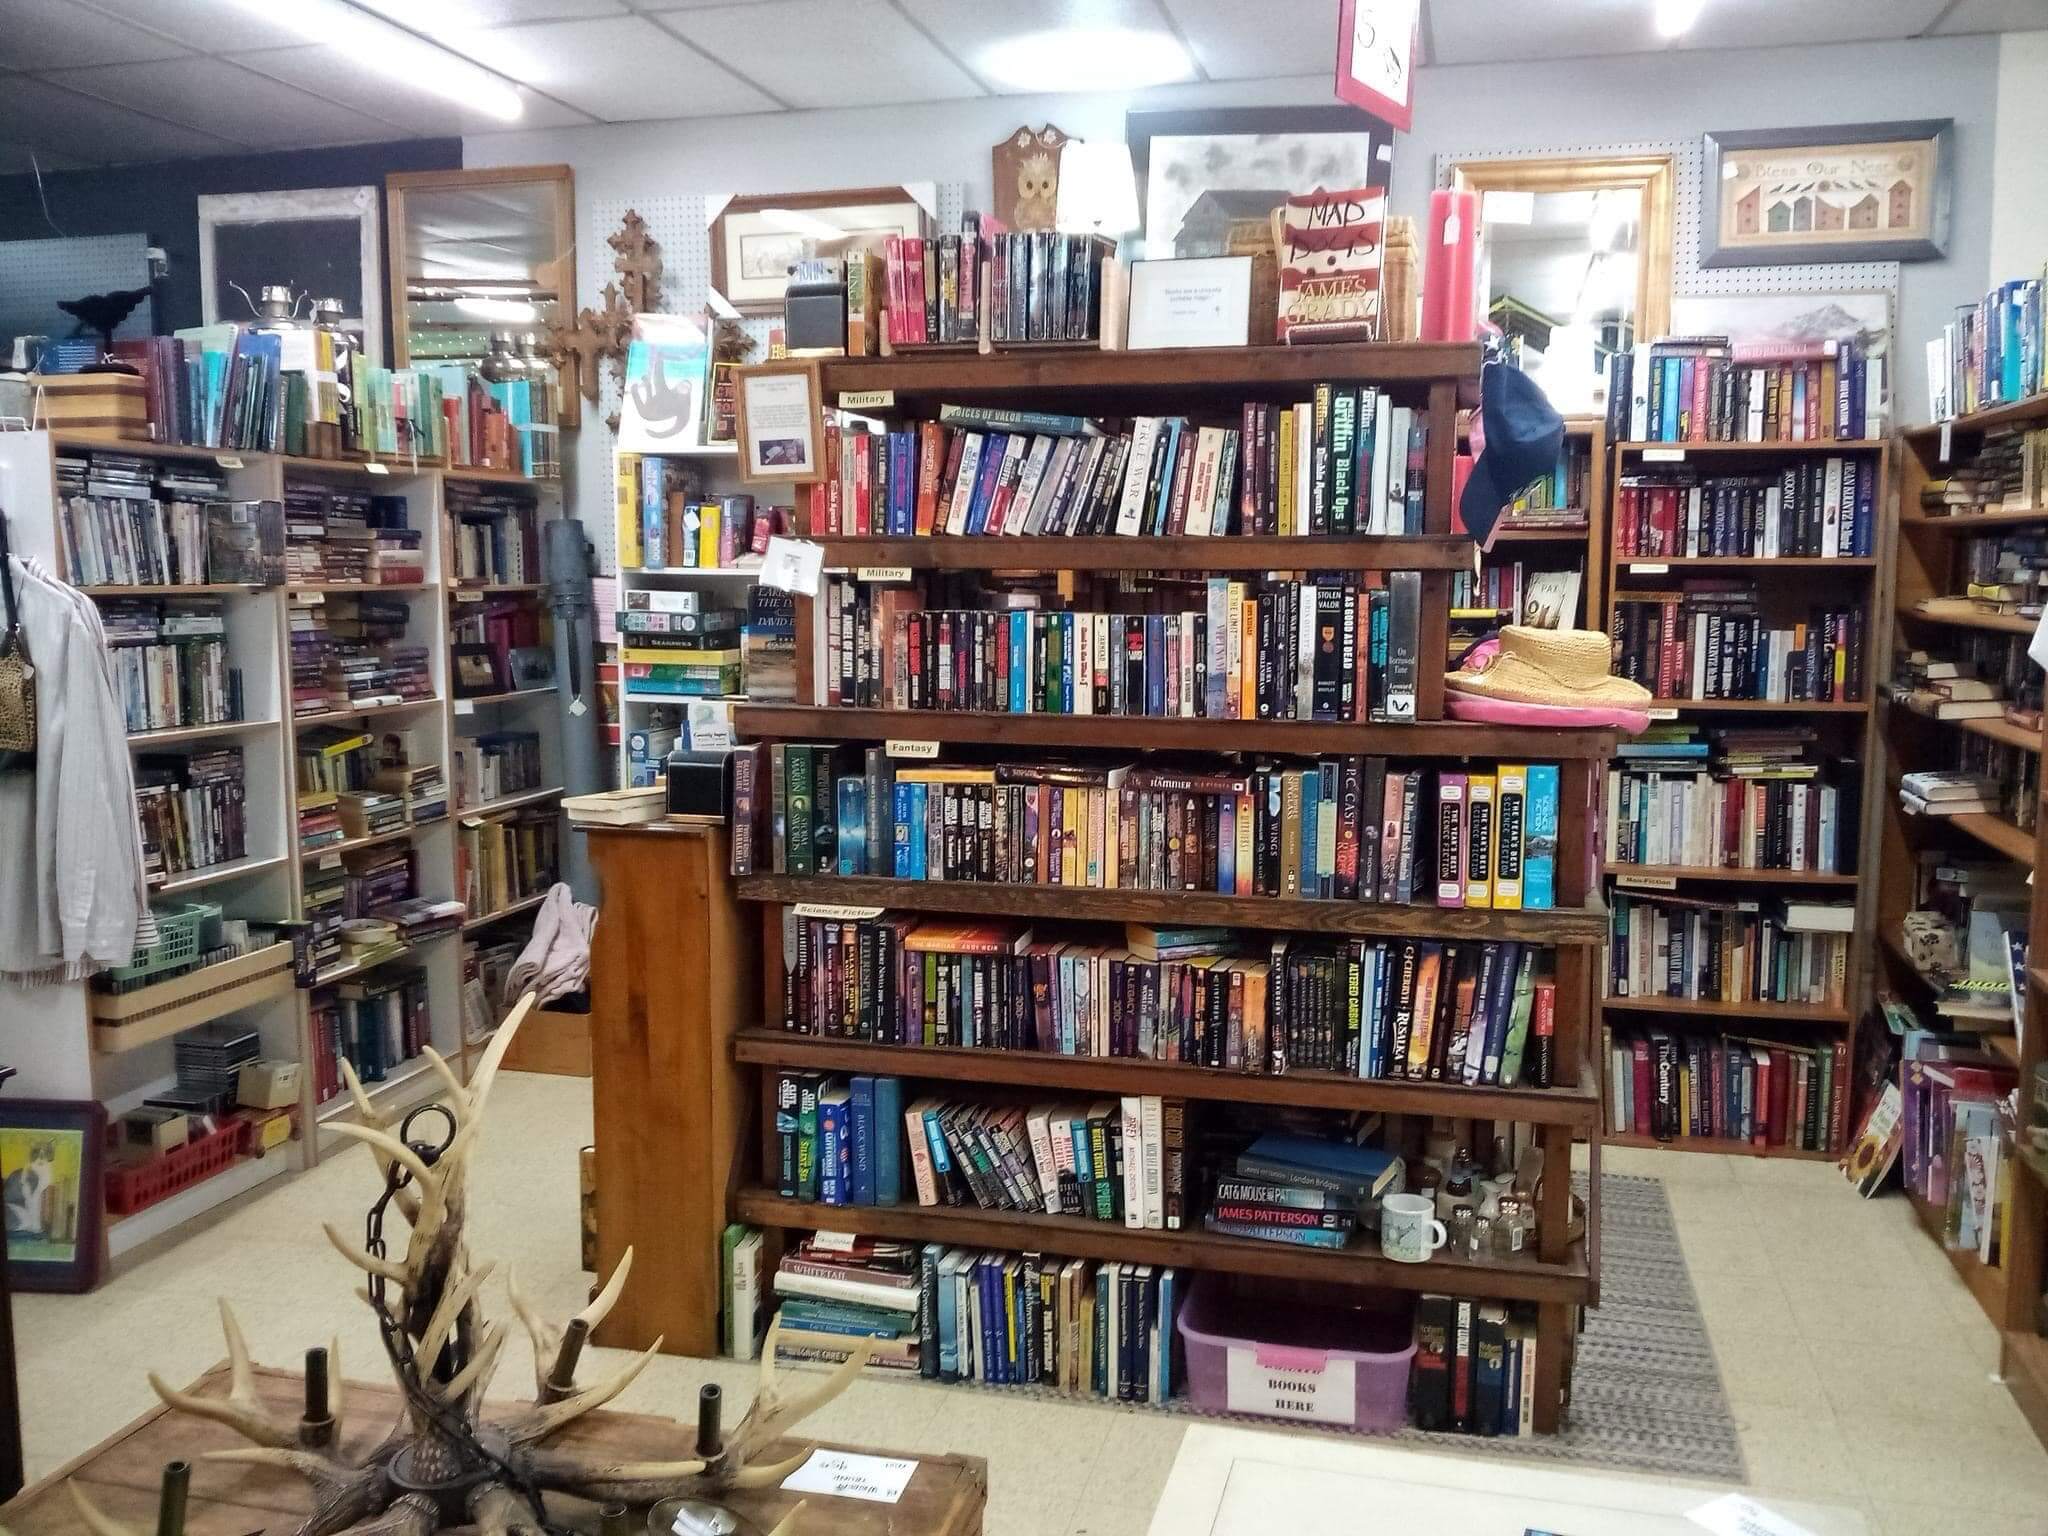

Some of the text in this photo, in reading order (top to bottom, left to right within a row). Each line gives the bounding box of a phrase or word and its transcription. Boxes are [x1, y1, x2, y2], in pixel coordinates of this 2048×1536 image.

[1306, 200, 1366, 230] MAD
[1290, 230, 1375, 263] DOGS
[1295, 277, 1368, 303] JAMES
[1286, 297, 1376, 325] GRADY
[847, 394, 886, 406] Military
[926, 439, 936, 471] SNIPER
[1128, 422, 1151, 498] TRUE WAR
[1331, 396, 1354, 521] Griffin Black Ops
[1841, 461, 1855, 521] DEAN KOONTZ
[866, 568, 905, 579] Military
[758, 598, 781, 607] THE
[1229, 586, 1238, 634] TO THE LIMIT
[1317, 591, 1341, 601] STOLEN
[1318, 601, 1340, 609] VALOR
[1343, 596, 1353, 608] AS
[757, 616, 784, 626] DAVID
[1343, 608, 1353, 633] GOOD
[1215, 624, 1226, 673] VIETNAM
[1708, 616, 1720, 667] DEAN KOONTZ
[1343, 646, 1353, 670] DEAD
[892, 743, 932, 754] Fantasy
[791, 757, 801, 792] MARTIN
[1286, 775, 1295, 820] SPYGLASS
[1343, 792, 1356, 828] CAST
[1402, 821, 1412, 834] and
[1451, 808, 1459, 823] THE
[1480, 808, 1489, 821] THE
[1534, 798, 1542, 832] FICTION
[791, 813, 801, 851] SWORDS
[801, 817, 809, 846] STORM
[1270, 822, 1279, 857] WINGS
[1401, 834, 1412, 852] Black
[1442, 804, 1451, 878] SCIENCE FICTION
[1471, 804, 1481, 878] SCIENCE FICTION
[1501, 796, 1511, 876] SCIENCE FICTION
[1509, 800, 1520, 872] THE YEAR'S BEST
[1399, 852, 1411, 881] Mountain
[1450, 855, 1459, 873] BEST
[1479, 855, 1488, 871] BEST
[800, 905, 840, 915] Science
[879, 930, 887, 947] BEST
[981, 944, 998, 952] WEIR
[848, 945, 856, 984] BALANCE
[1126, 977, 1135, 1016] LEGACY
[1141, 984, 1149, 1014] WORLDS
[1348, 963, 1360, 1030] ALTERED CARBON
[1394, 1012, 1410, 1061] RUSALKA
[1659, 1044, 1671, 1104] The Century
[781, 1079, 790, 1109] CUSSLER
[788, 1084, 797, 1105] CLIVE
[857, 1114, 867, 1171] BLACK WIND
[1126, 1117, 1137, 1142] PREY
[800, 1140, 809, 1182] SILENT SEA
[1053, 1136, 1065, 1169] CRICHTON
[1063, 1136, 1074, 1168] MICHAEL
[1092, 1128, 1105, 1179] MICHAEL CRICHTON
[1146, 1143, 1159, 1166] MICHAEL
[1129, 1174, 1137, 1202] CRICHTON
[1147, 1168, 1159, 1196] CRICHTON
[1240, 1185, 1267, 1202] MOUSE
[1289, 1175, 1340, 1191] London Bridges
[1096, 1181, 1112, 1220] SPHERE
[1217, 1206, 1319, 1226] JAMES PATTERSON
[1248, 1227, 1306, 1241] PATTERSON
[793, 1264, 847, 1281] WHITETAIL
[1268, 1379, 1317, 1394] BOOKS
[1275, 1399, 1315, 1412] HERE
